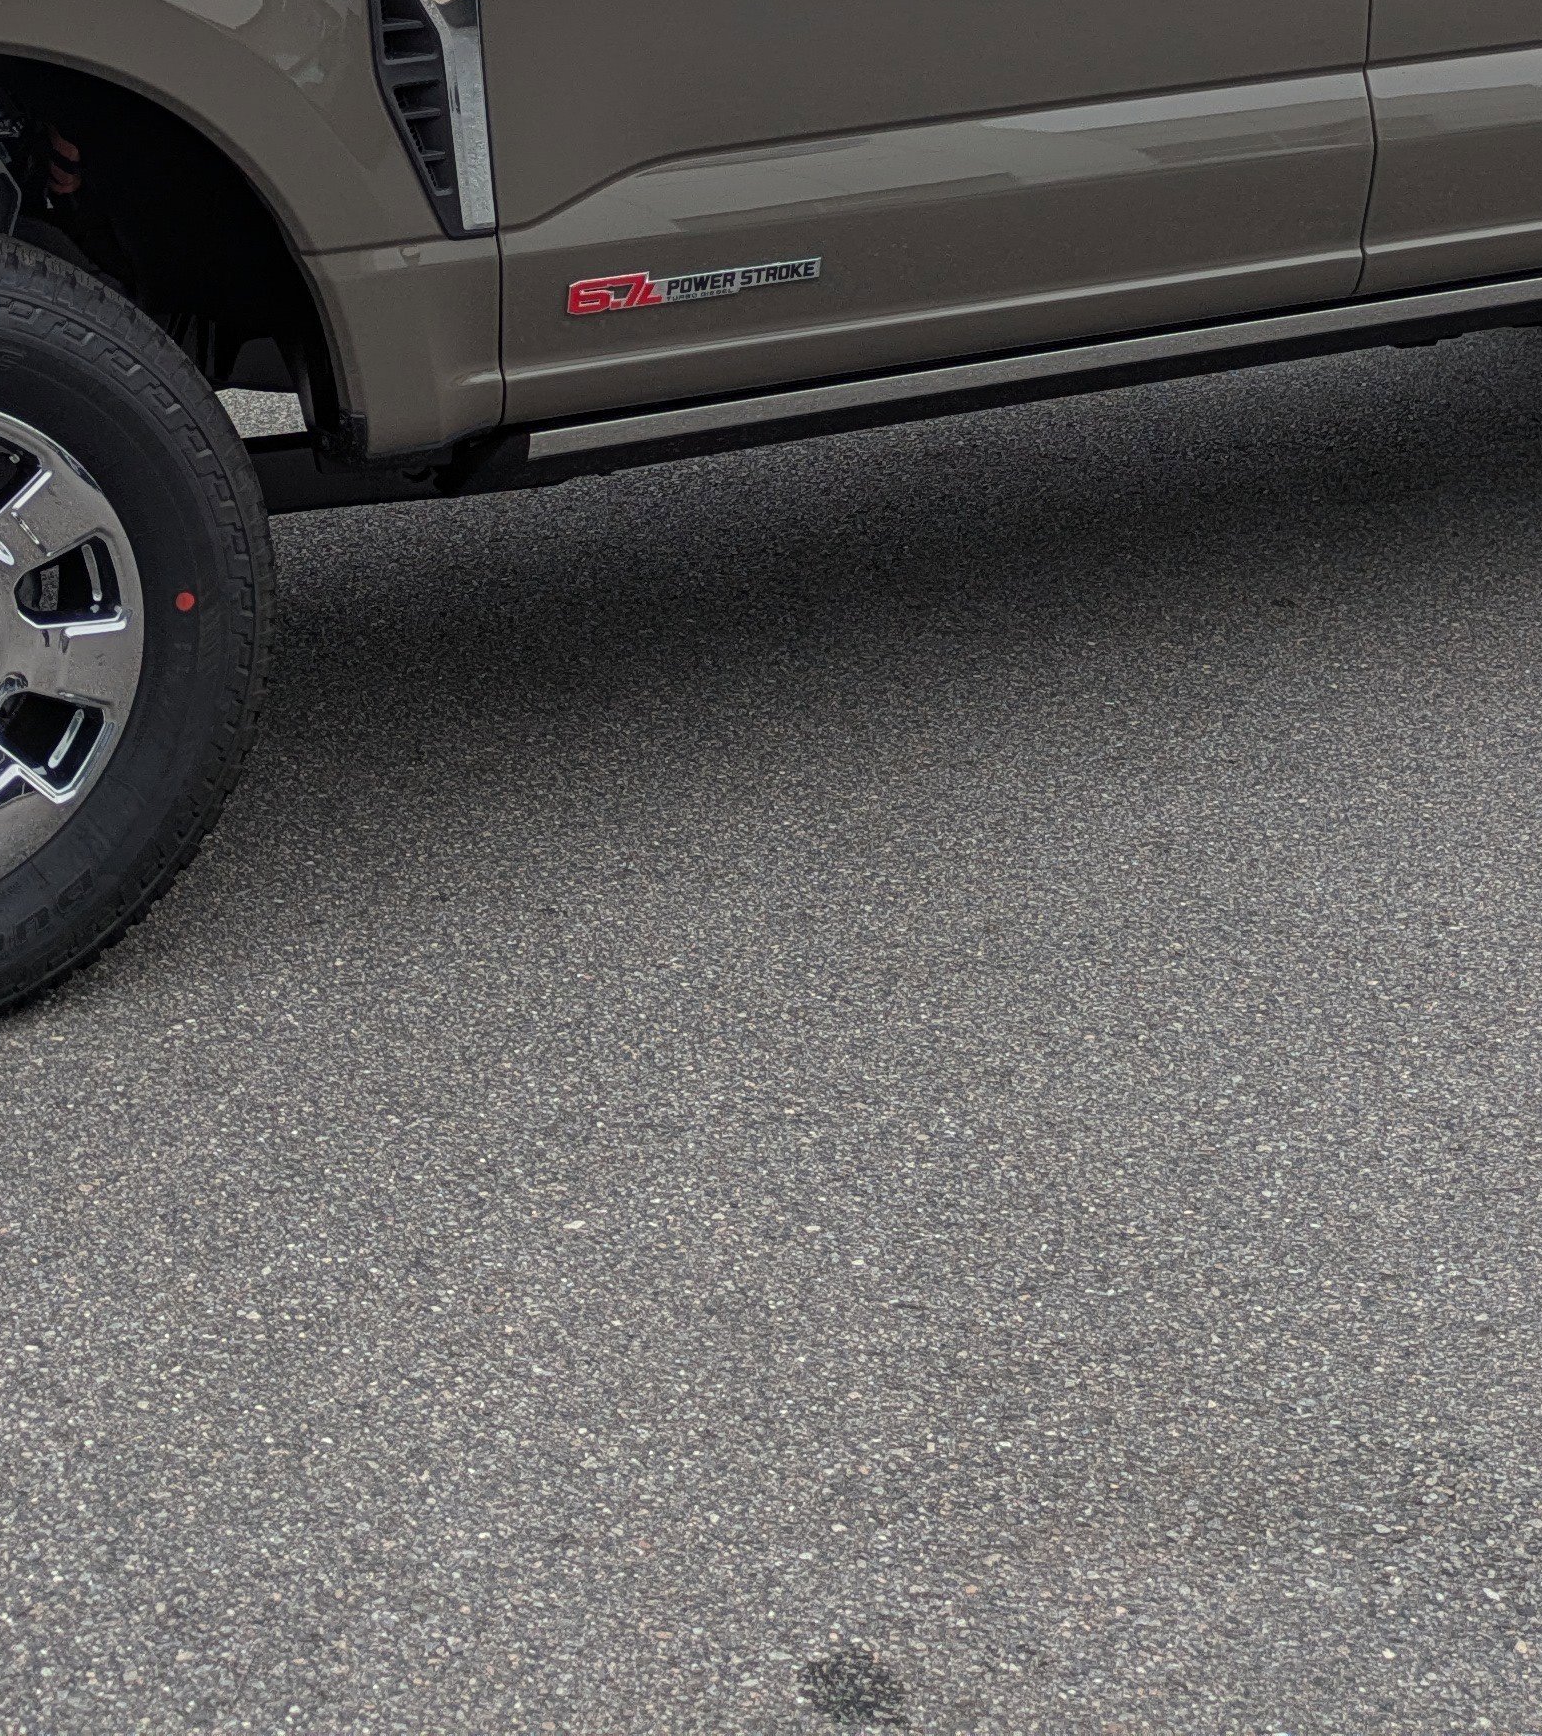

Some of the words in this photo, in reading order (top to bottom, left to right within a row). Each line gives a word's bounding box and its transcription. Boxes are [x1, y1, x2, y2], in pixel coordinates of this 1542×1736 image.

[567, 271, 663, 315] 6.7L
[666, 271, 735, 295] POWER
[740, 260, 818, 286] STROKE
[666, 293, 698, 302] TURBO
